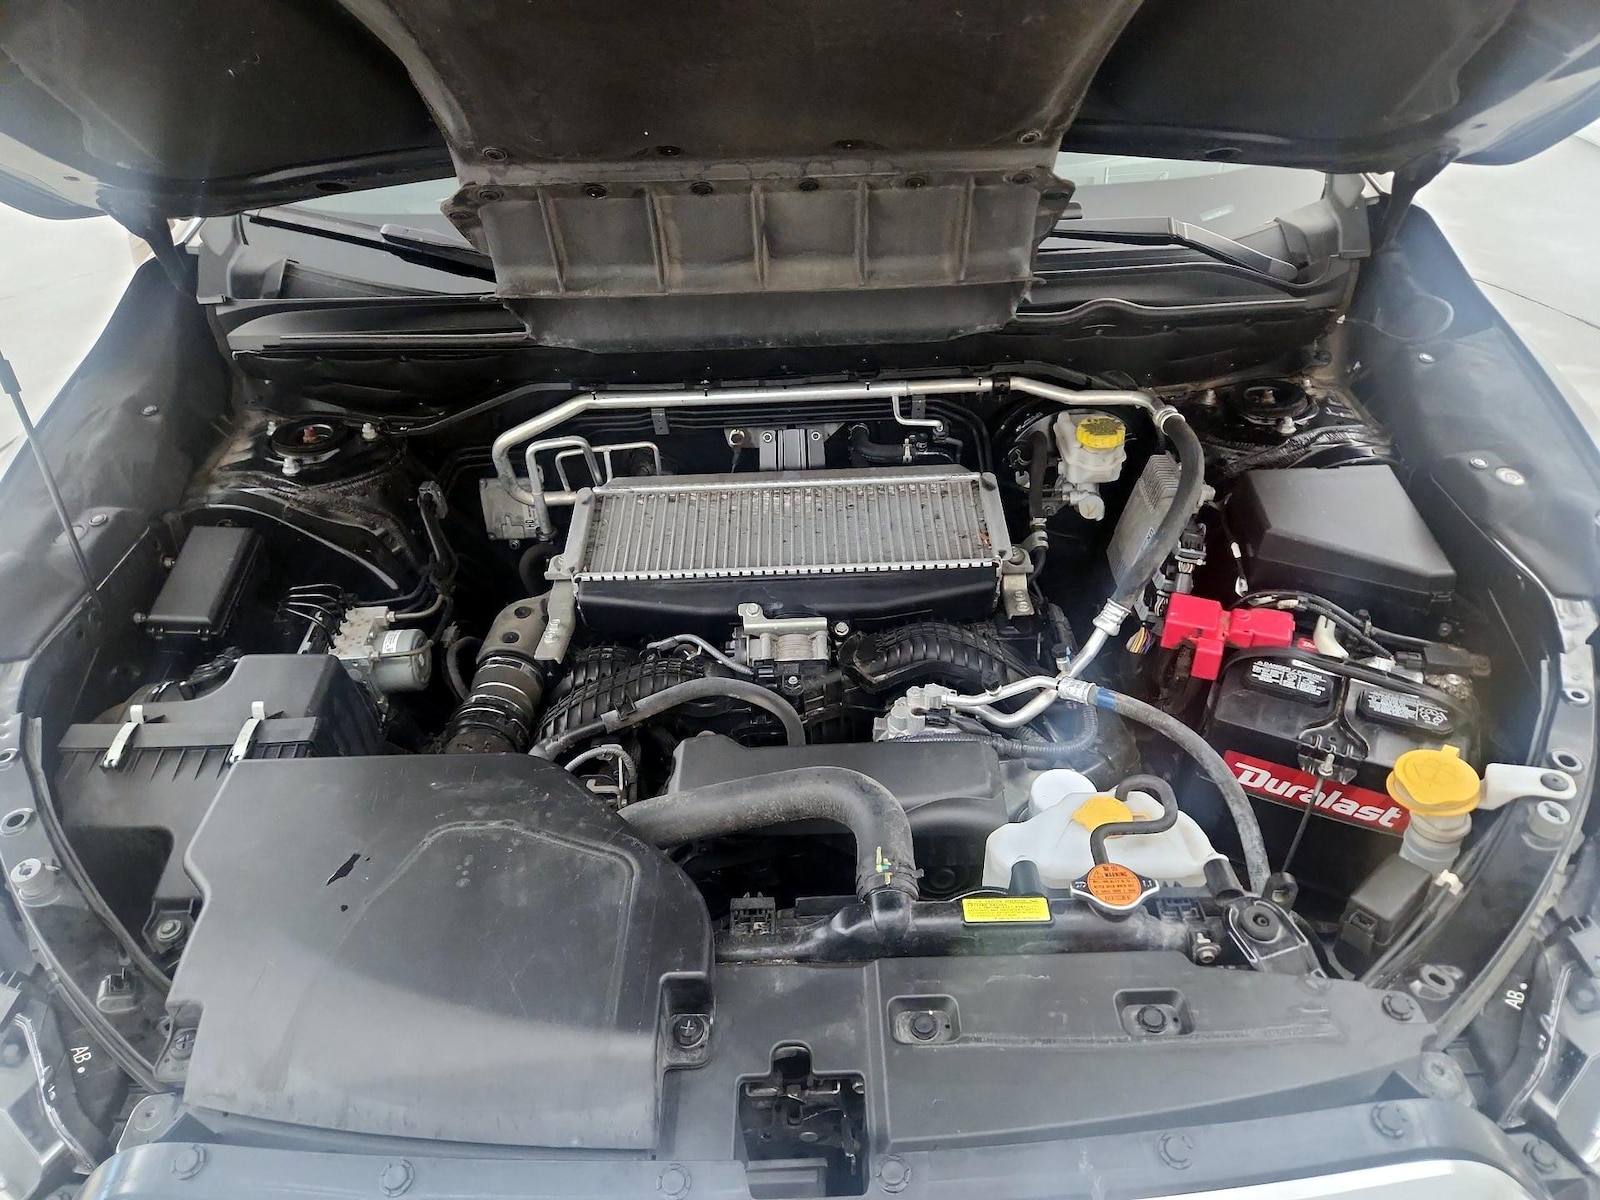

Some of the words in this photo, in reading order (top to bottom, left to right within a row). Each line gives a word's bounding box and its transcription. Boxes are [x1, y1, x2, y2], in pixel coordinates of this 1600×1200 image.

[1235, 762, 1402, 827] Duralast
[1505, 990, 1525, 1010] AB
[70, 1046, 92, 1064] AB
